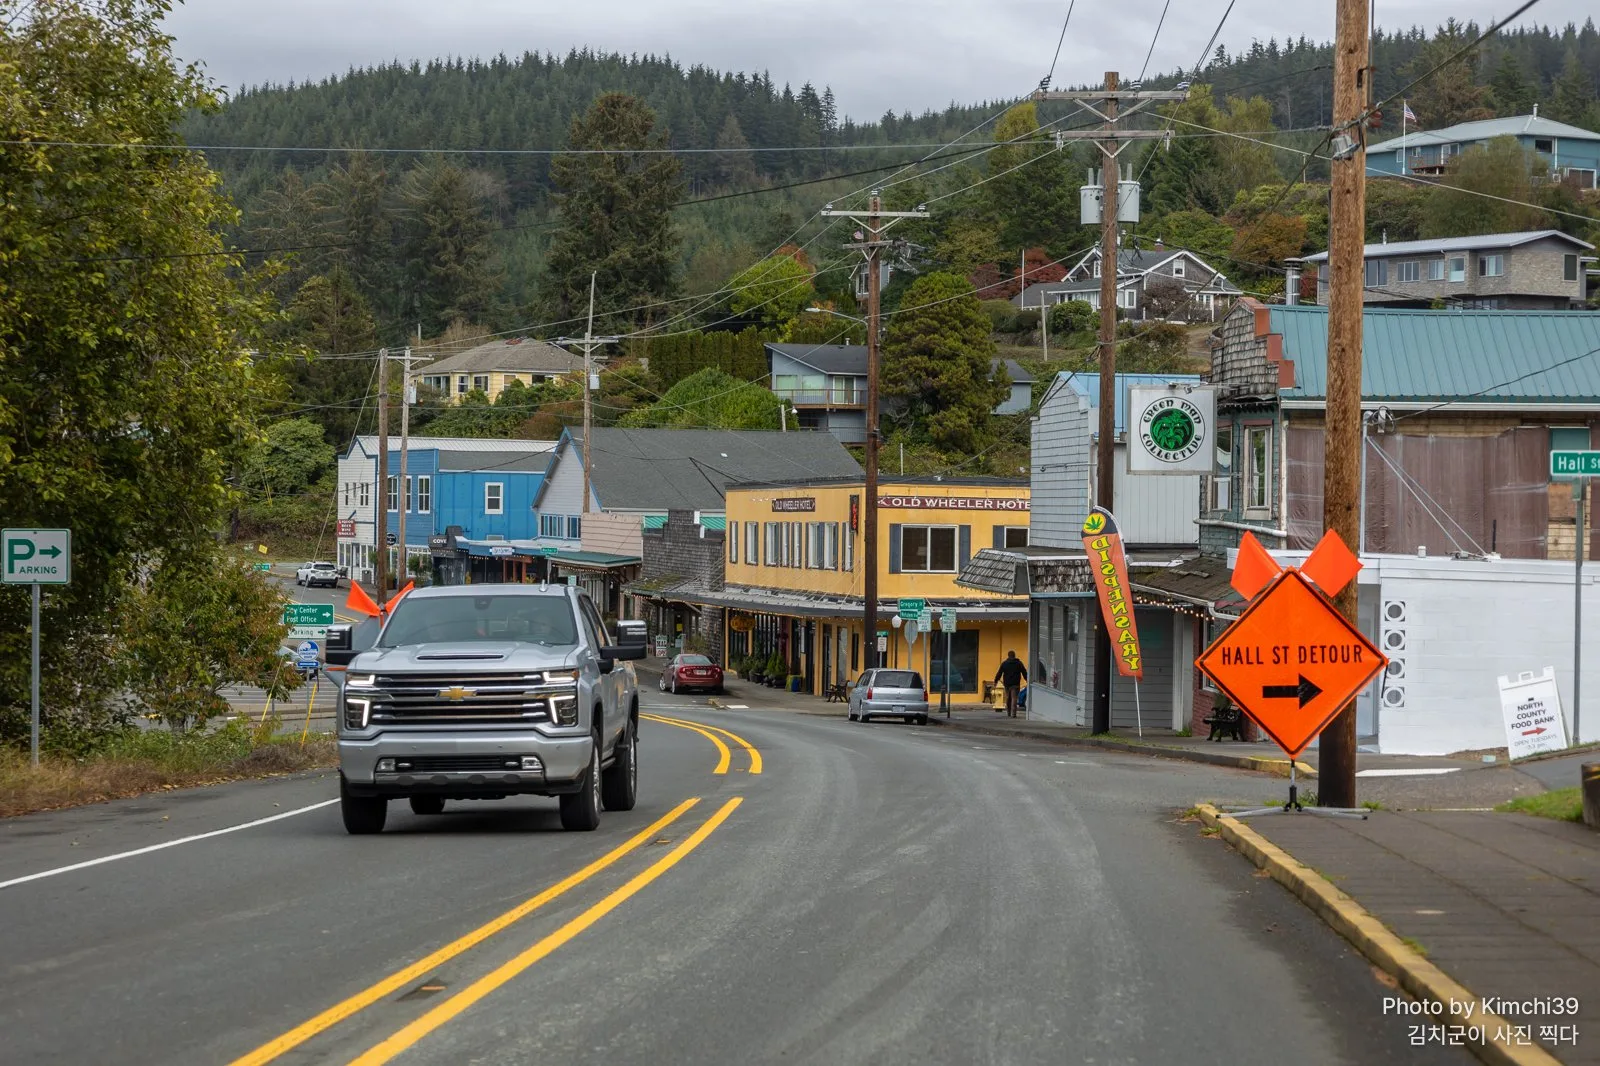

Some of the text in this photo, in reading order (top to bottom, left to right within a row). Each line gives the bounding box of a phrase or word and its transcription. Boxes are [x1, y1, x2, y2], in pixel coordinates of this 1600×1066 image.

[1143, 399, 1202, 424] GREEN MAN
[1558, 456, 1585, 470] Hall
[891, 497, 1031, 510] OLD WHEELER HOTE
[286, 606, 318, 615] Cy Center
[1222, 645, 1362, 665] HALL ST DETOUR
[1518, 702, 1543, 710] NORTH
[1517, 709, 1546, 720] COUNTY
[1511, 716, 1554, 730] FOOD BANK
